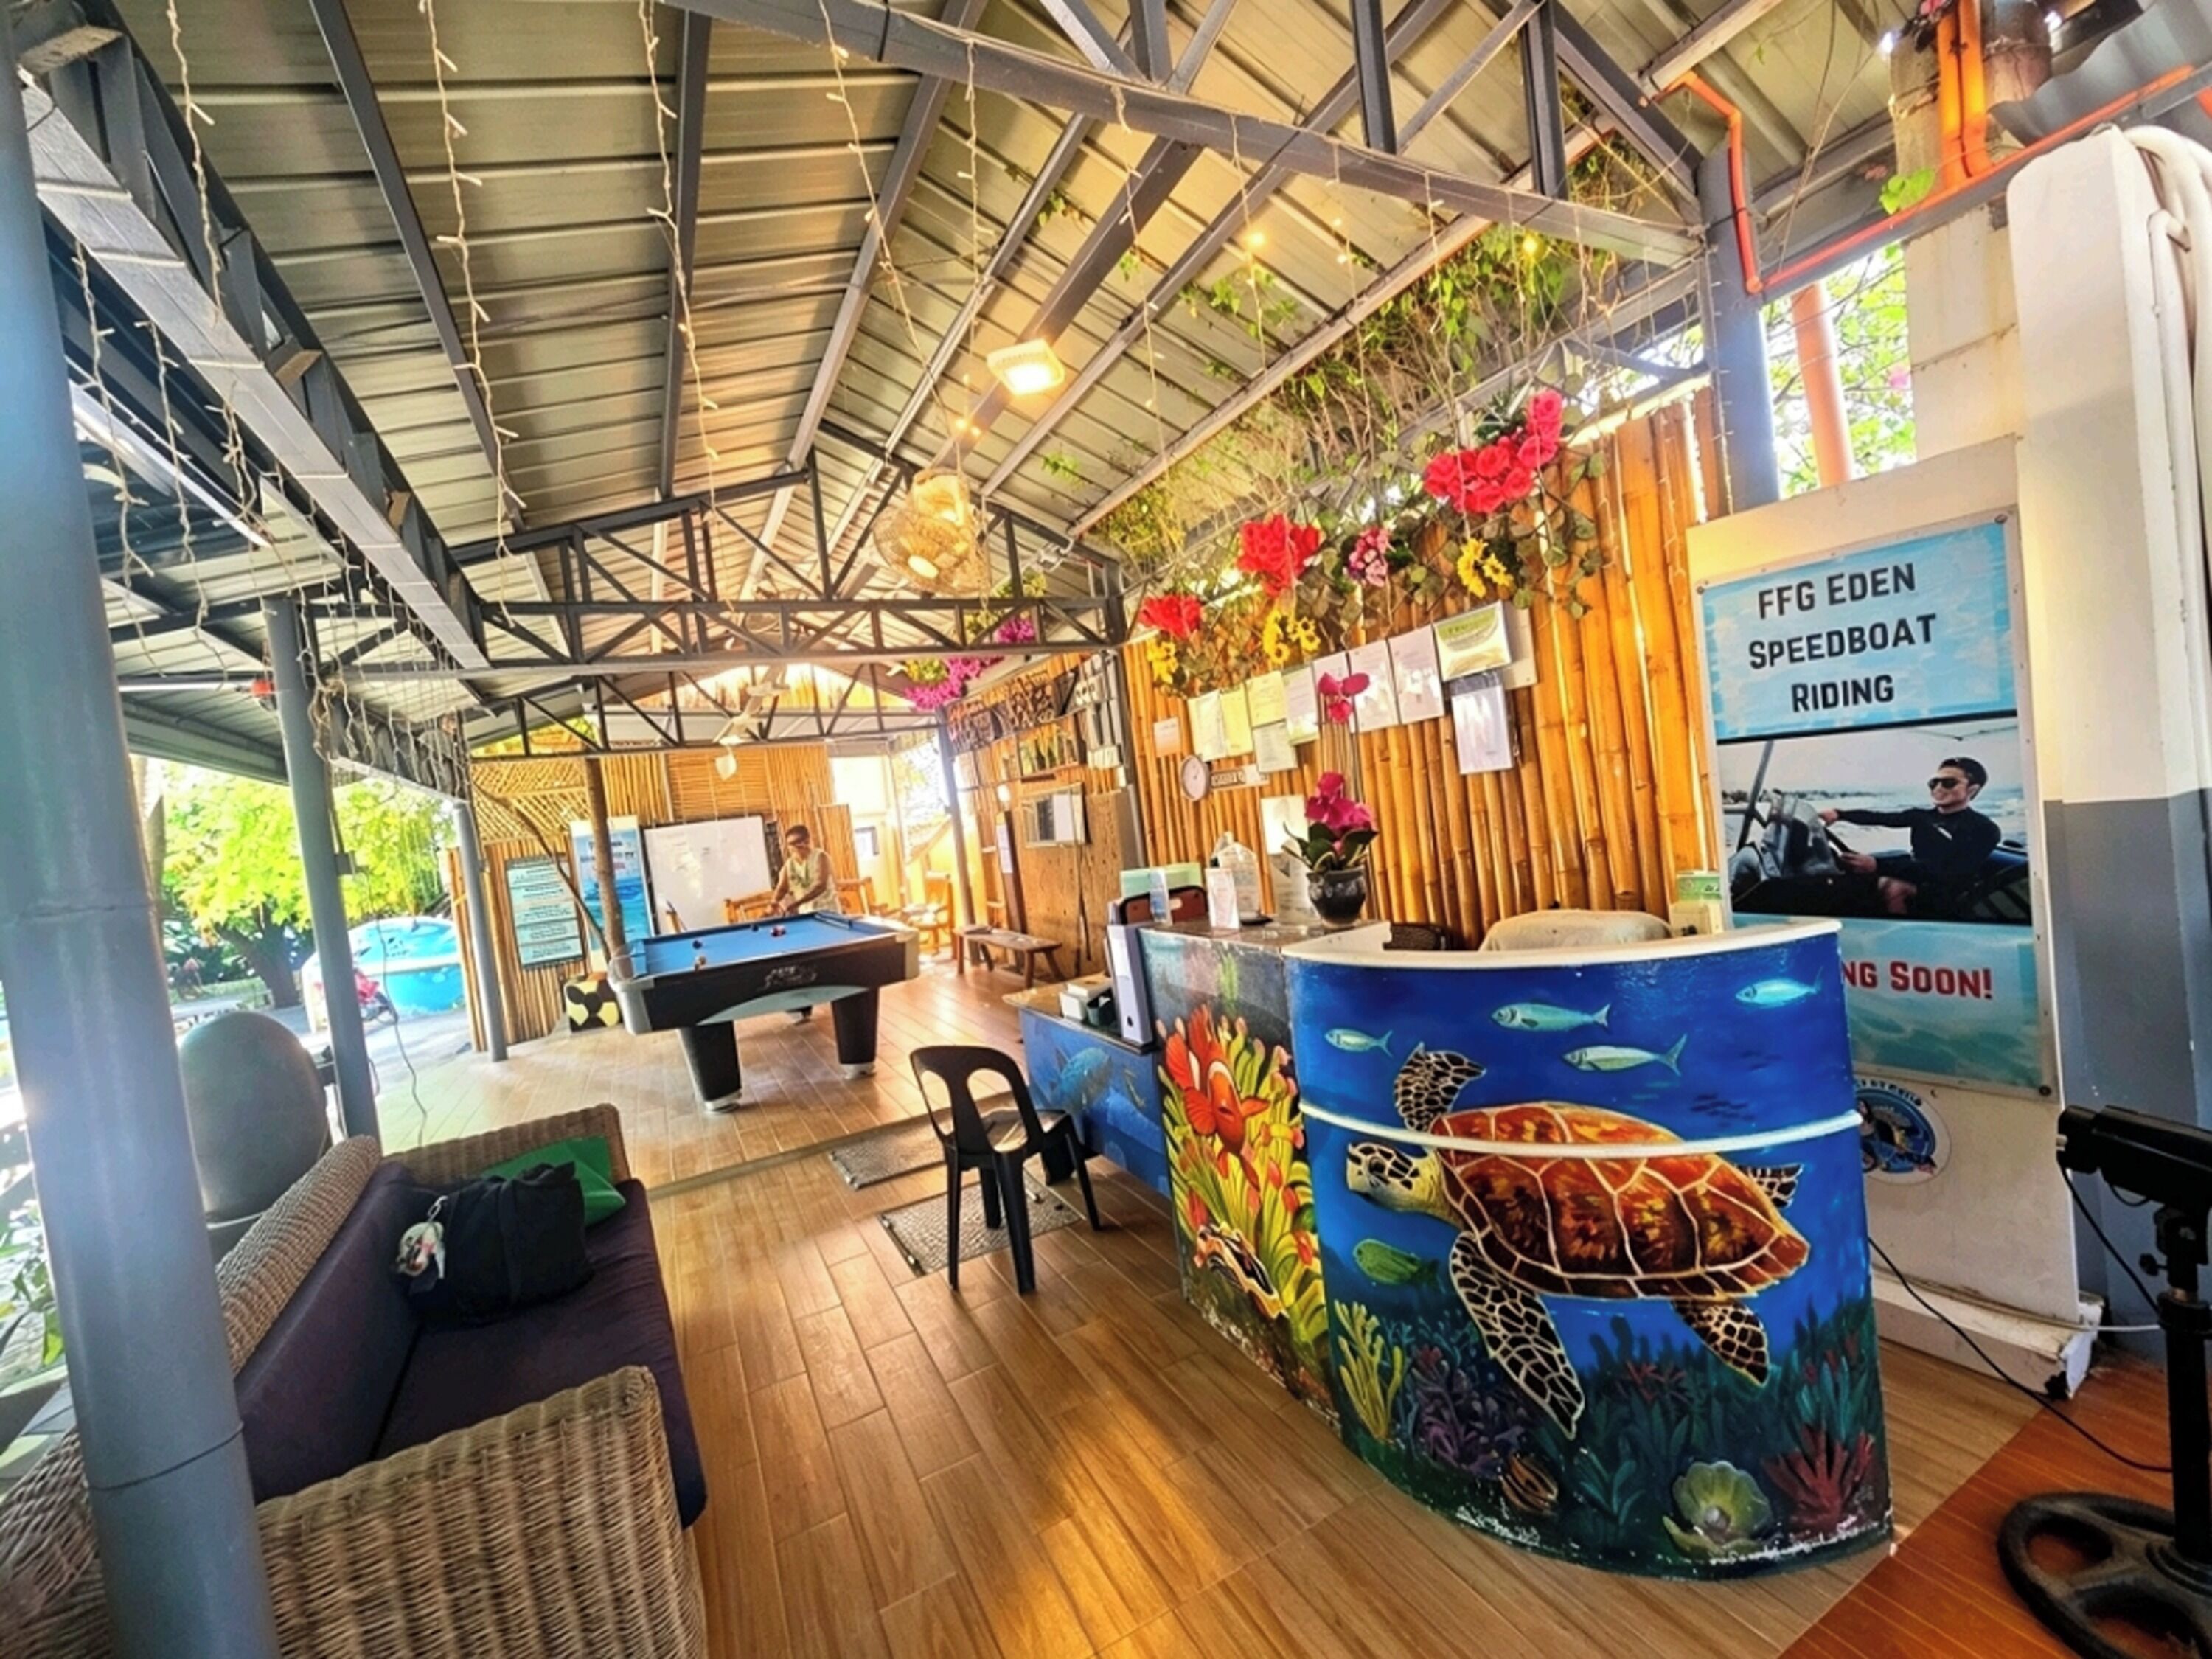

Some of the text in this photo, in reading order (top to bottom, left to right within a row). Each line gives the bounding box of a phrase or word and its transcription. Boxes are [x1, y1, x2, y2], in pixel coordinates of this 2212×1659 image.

[1758, 563, 1916, 619] FFG EDEN
[1748, 613, 1937, 669] SPEEDBOAT
[1791, 675, 1894, 713] RIDING
[1890, 961, 1993, 1000] SOON!
